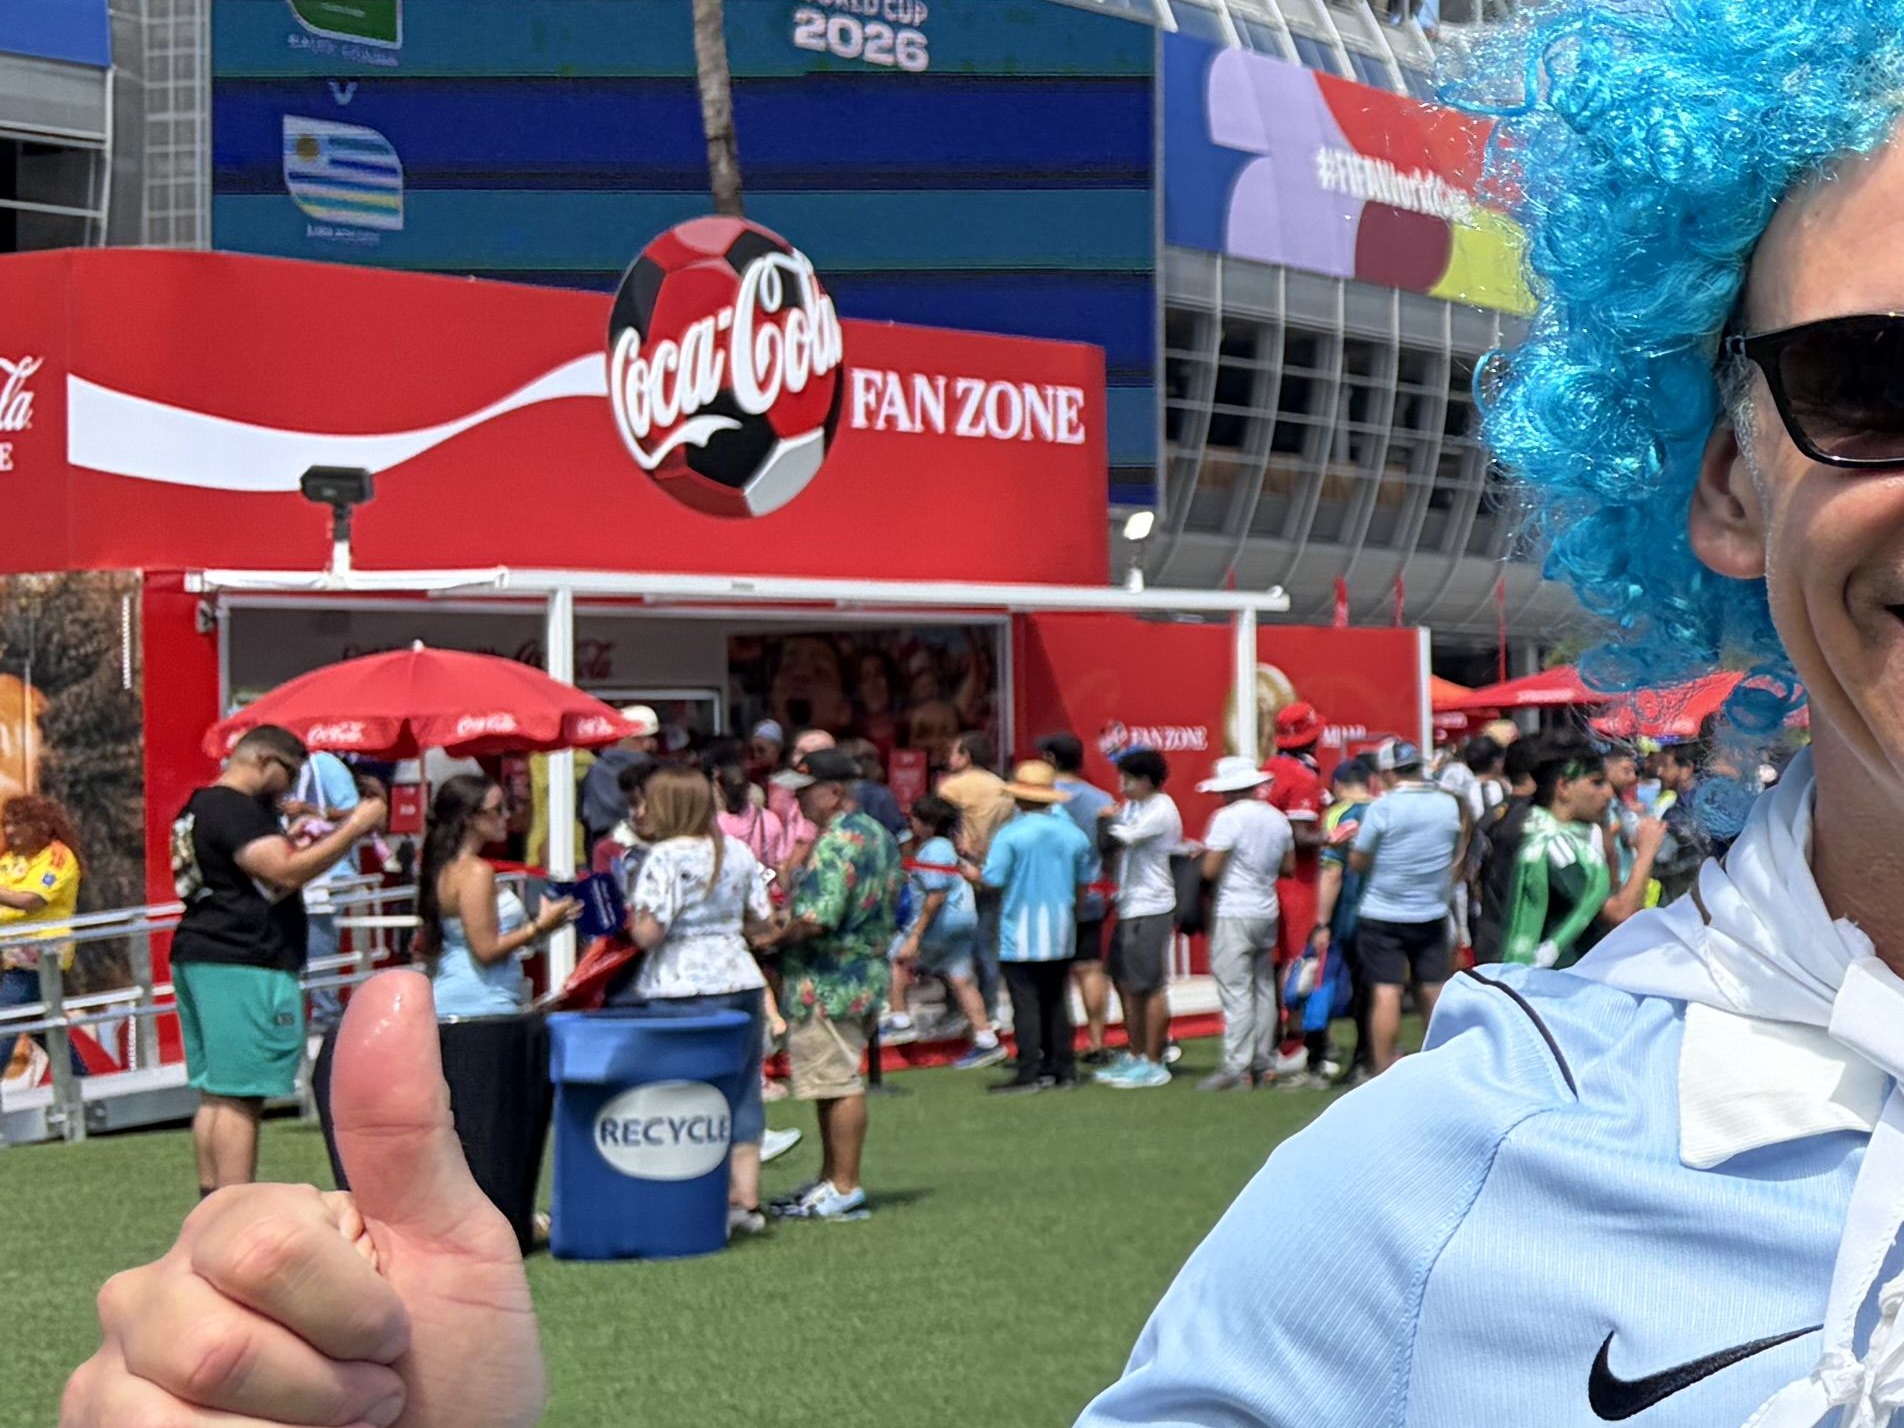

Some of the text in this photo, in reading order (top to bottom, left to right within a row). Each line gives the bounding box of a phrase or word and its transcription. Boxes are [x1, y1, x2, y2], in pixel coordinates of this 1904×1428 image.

[793, 6, 930, 73] 2026
[610, 248, 1087, 470] Coca-Cola FAN ZONE
[1164, 726, 1208, 751] ZONE
[600, 1115, 730, 1147] RECYCLE
